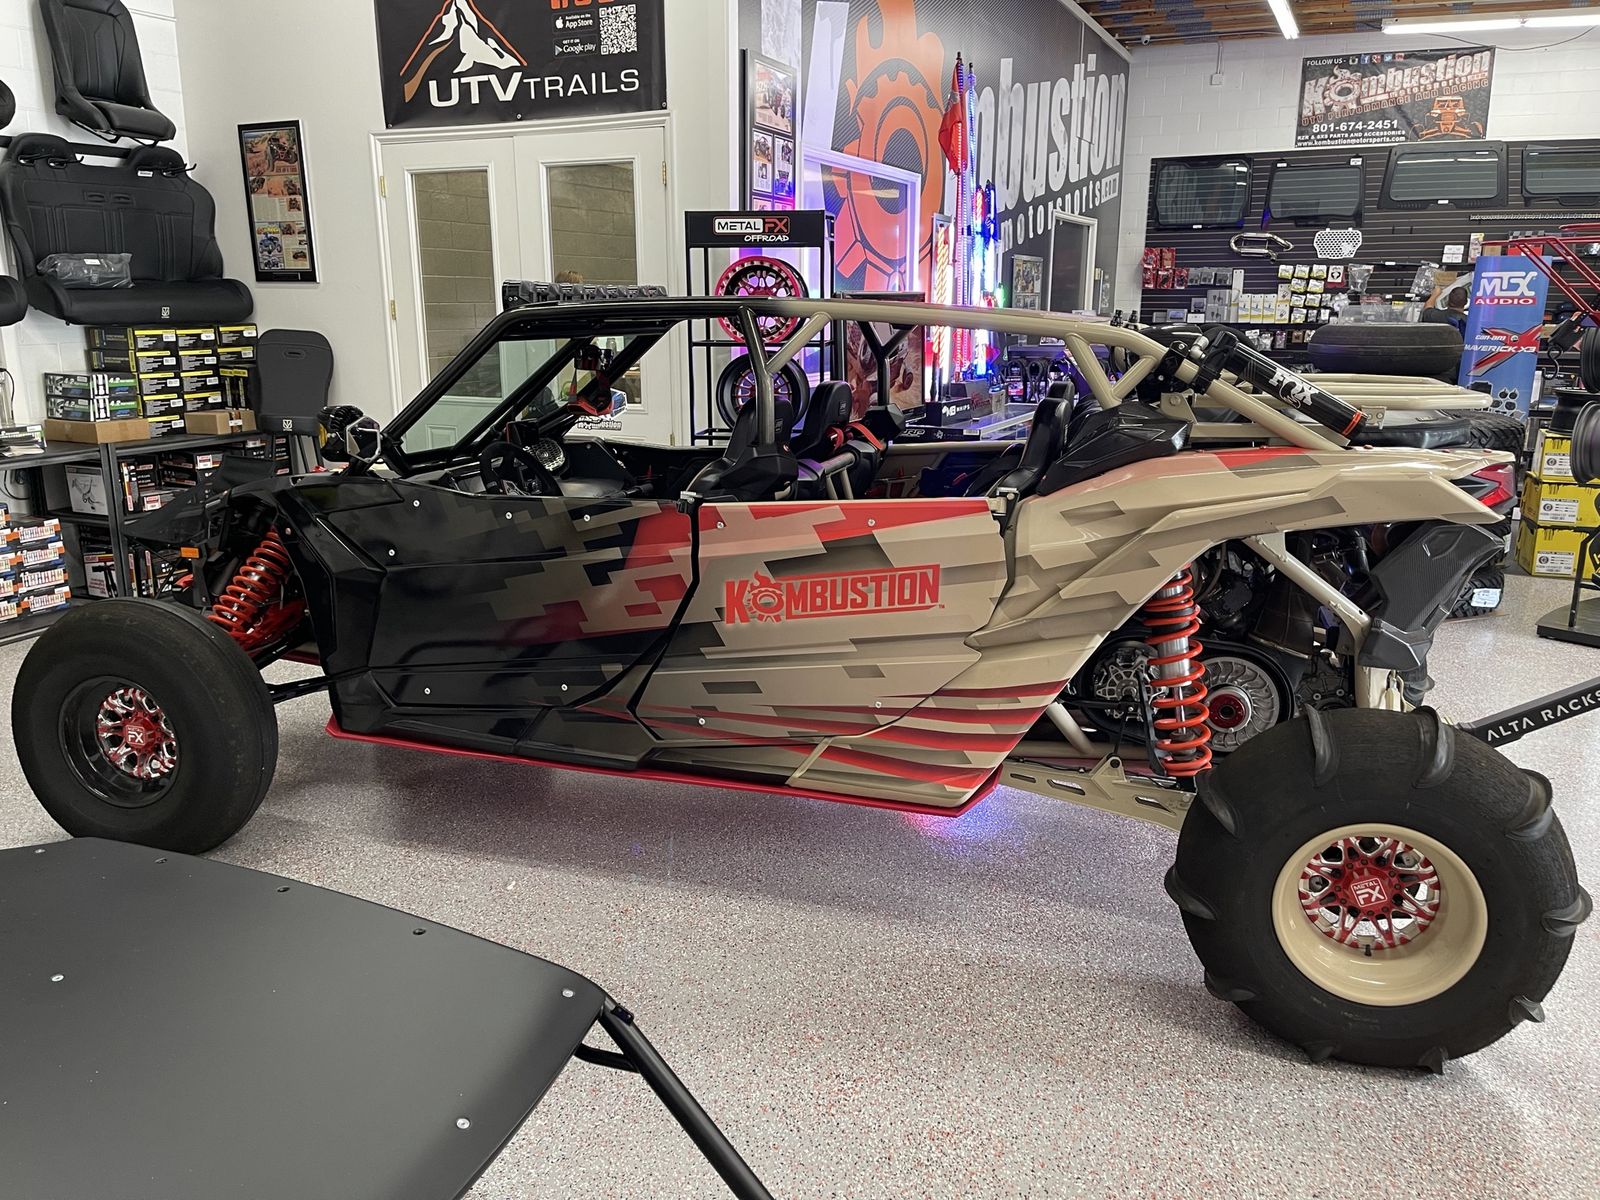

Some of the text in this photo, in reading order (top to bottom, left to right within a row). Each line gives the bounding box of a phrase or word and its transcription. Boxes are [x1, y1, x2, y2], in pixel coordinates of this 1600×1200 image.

[566, 20, 578, 29] App
[563, 43, 596, 54] Google play
[1306, 58, 1333, 66] FOLLOW
[428, 68, 640, 108] UTV TRAILS
[1389, 76, 1467, 98] motorsports
[1301, 79, 1489, 127] UTV PERFORMANCE AND RACING
[1312, 119, 1398, 133] 801-674-2451
[1296, 136, 1406, 147] www.kombustionmotorsports.com
[717, 218, 789, 233] METAL FX
[744, 234, 790, 242] OFFROAD
[1476, 271, 1538, 297] MTX
[1464, 344, 1518, 353] MAVERICK
[1268, 367, 1320, 408] FOX
[725, 568, 940, 625] KOMBUSTION
[1487, 717, 1535, 742] ALTA
[128, 730, 144, 744] FX
[1353, 880, 1379, 890] METAL
[1356, 886, 1385, 905] FX
